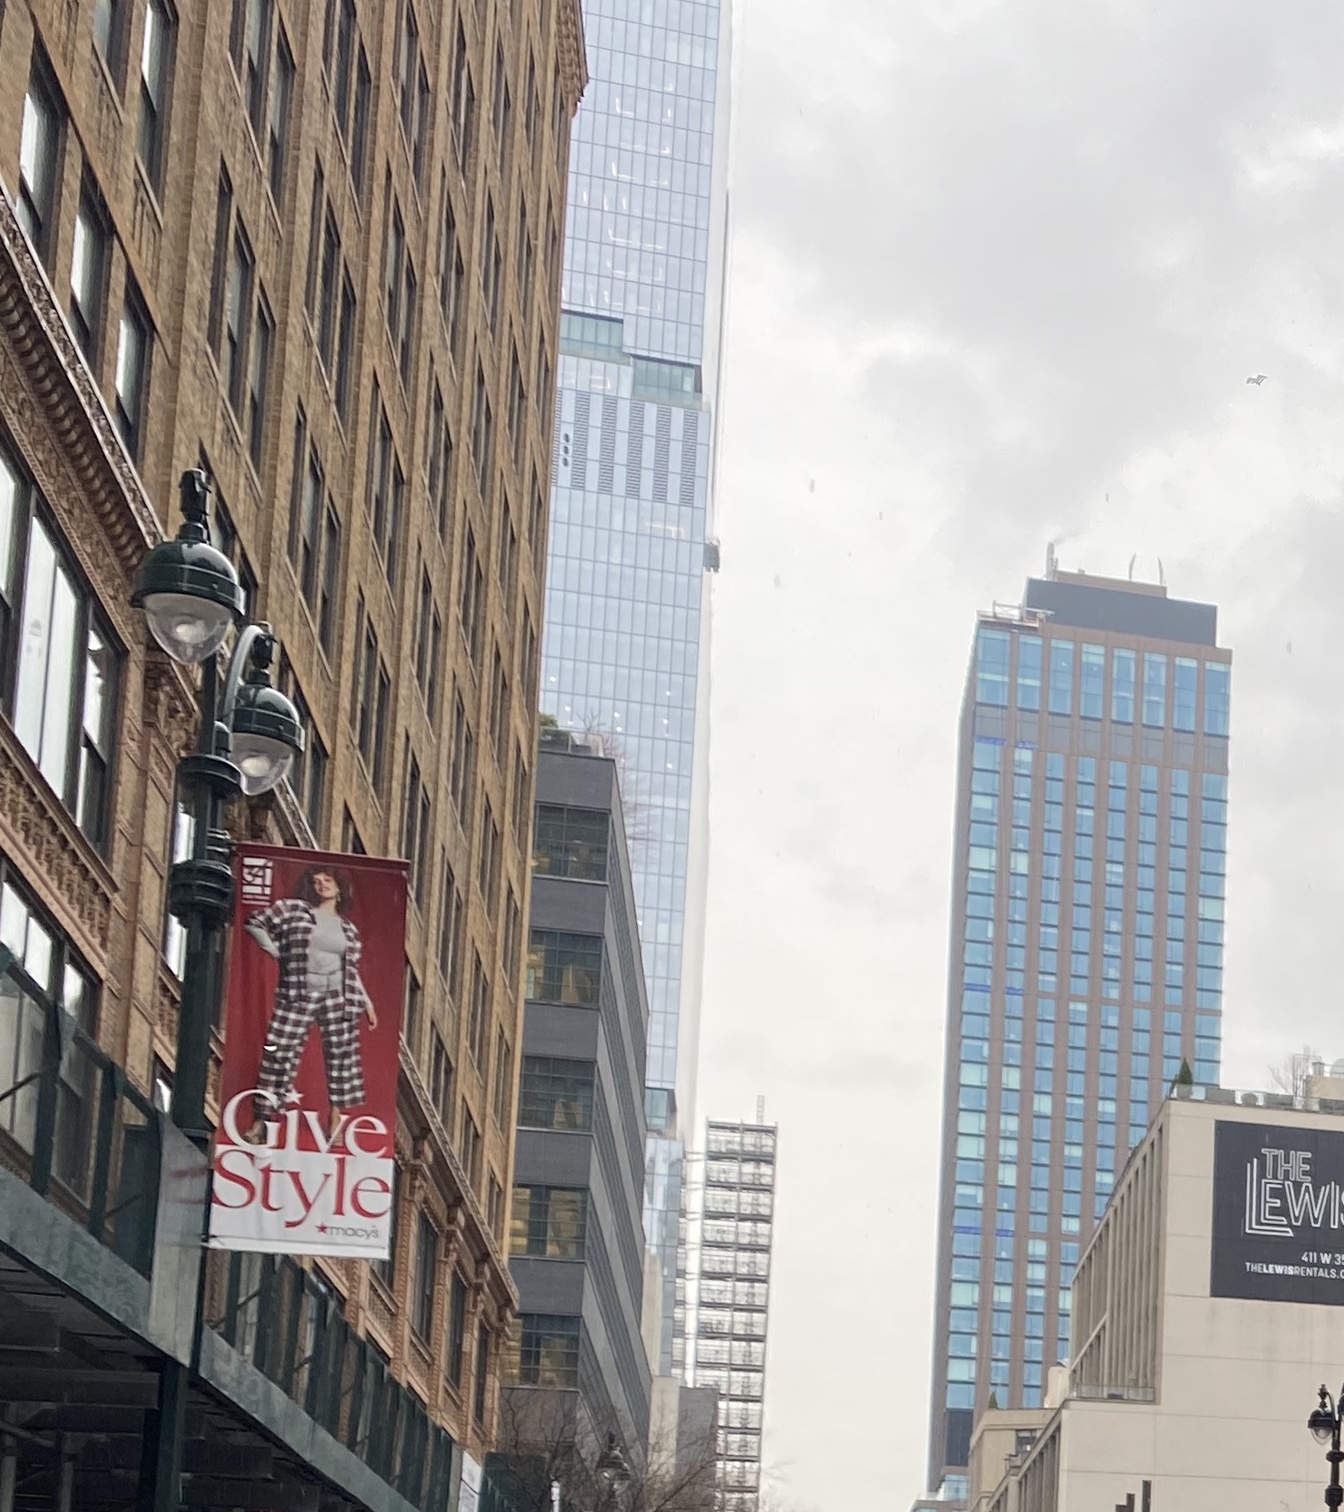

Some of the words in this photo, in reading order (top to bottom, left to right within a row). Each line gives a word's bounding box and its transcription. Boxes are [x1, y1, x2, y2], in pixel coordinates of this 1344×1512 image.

[223, 1085, 388, 1158] Give
[211, 1149, 391, 1228] Style
[1261, 1147, 1312, 1182] THE
[1301, 1251, 1318, 1263] 411
[1320, 1253, 1331, 1264] W
